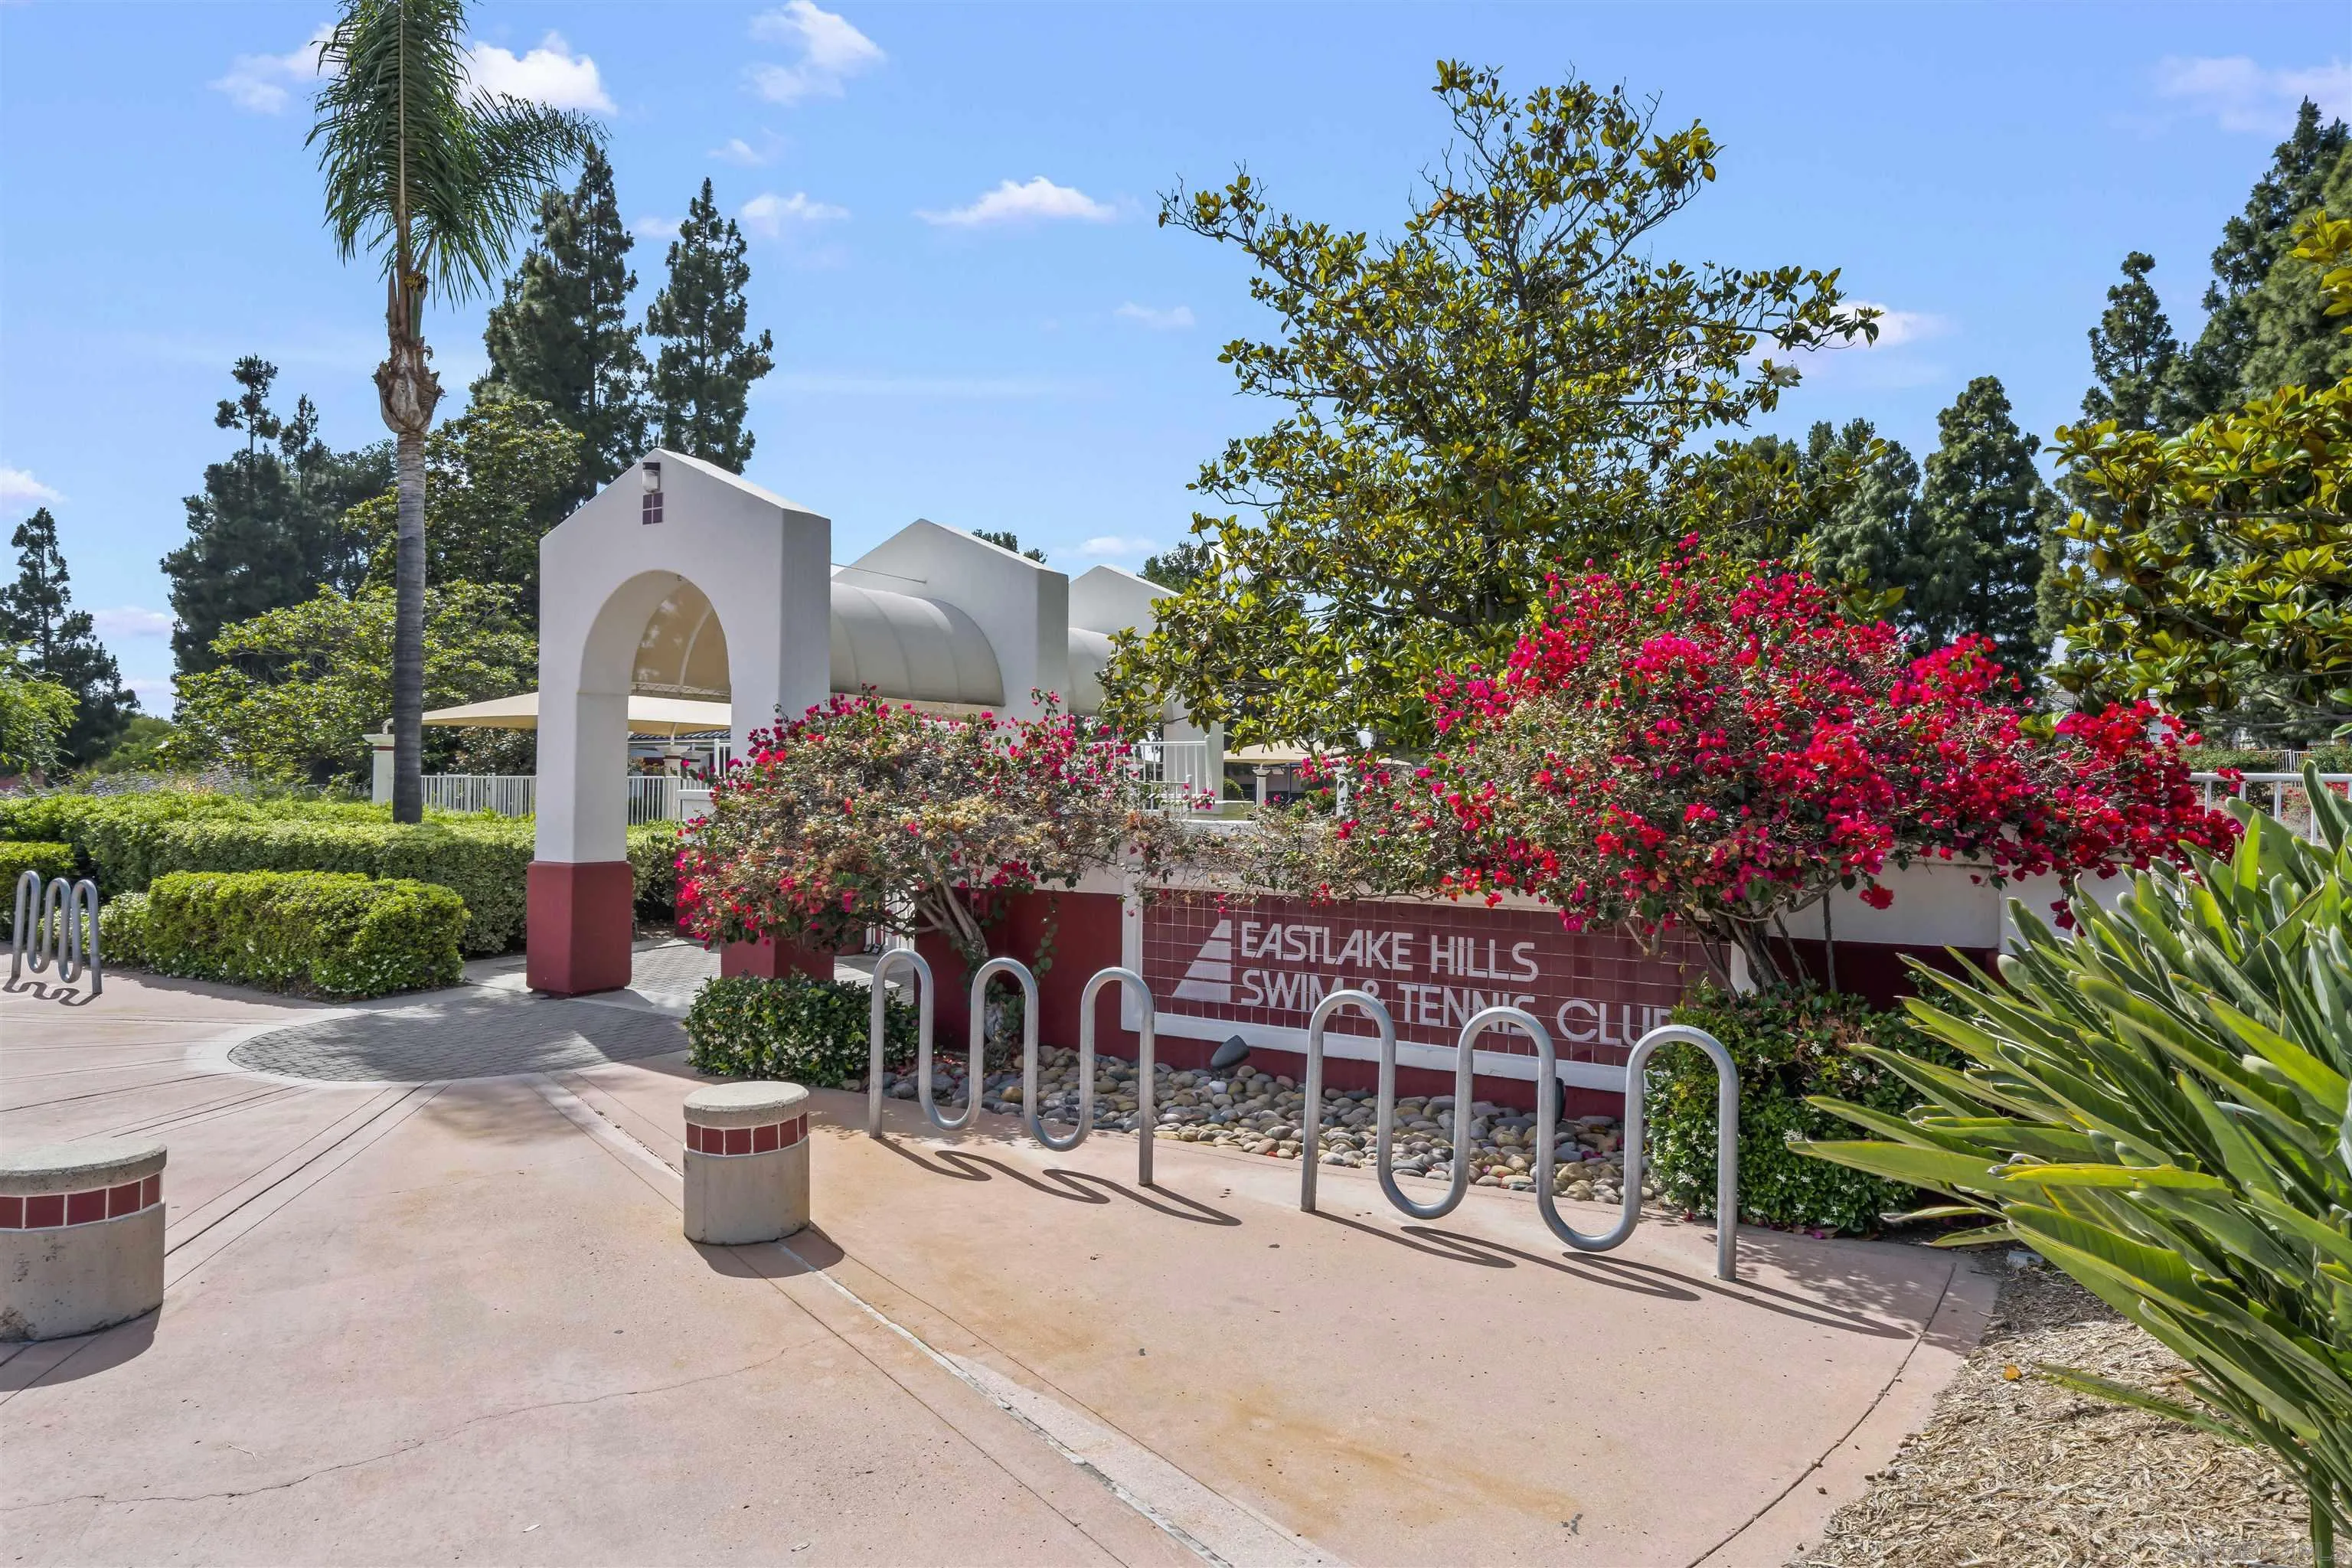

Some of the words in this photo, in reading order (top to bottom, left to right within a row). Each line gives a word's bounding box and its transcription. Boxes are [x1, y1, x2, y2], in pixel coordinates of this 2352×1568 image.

[1241, 921, 1413, 971] EASTLAKE
[1430, 935, 1539, 982] HILLS
[1240, 969, 1344, 1015] SWIM
